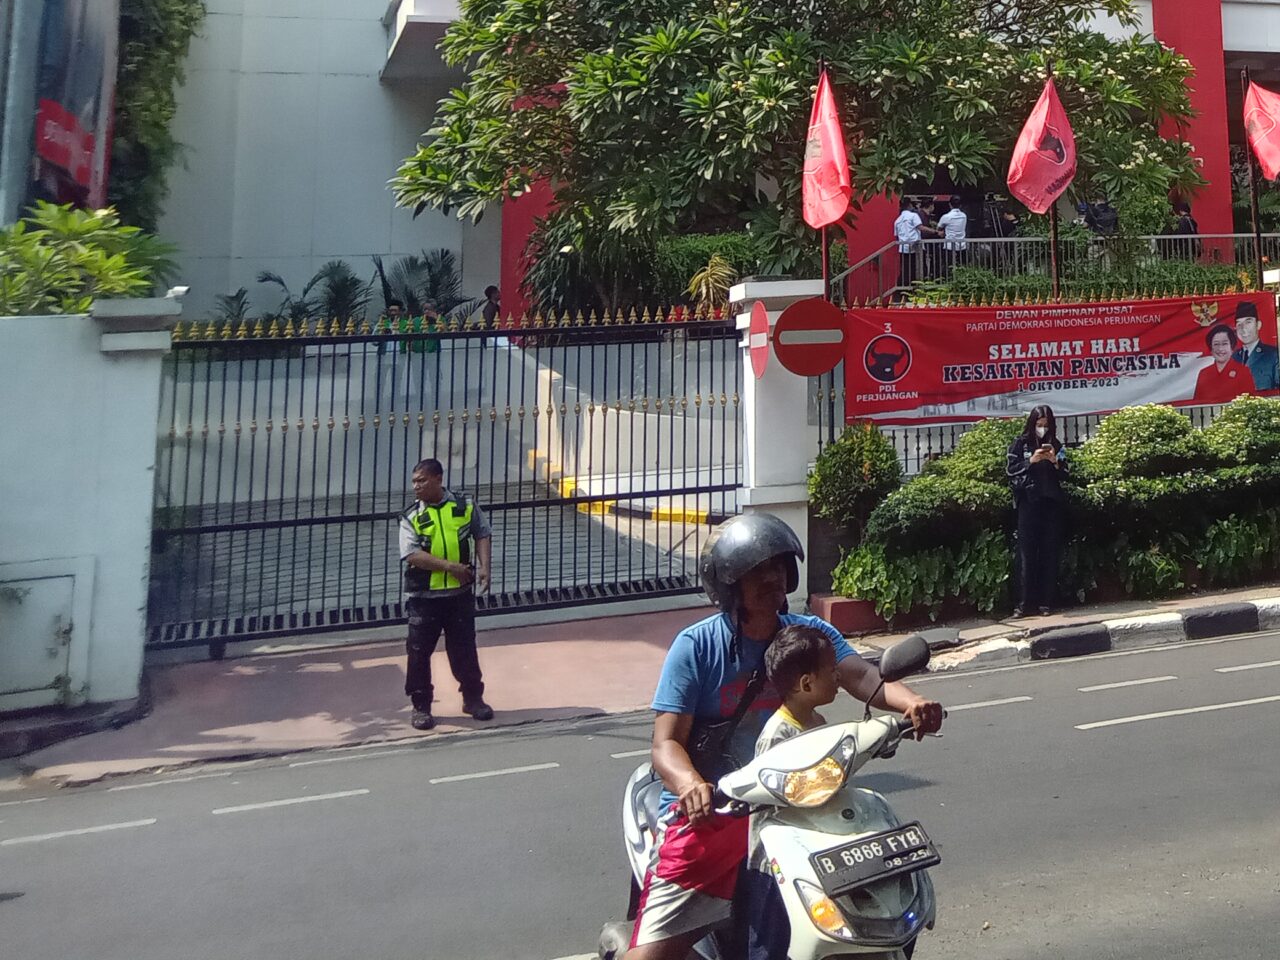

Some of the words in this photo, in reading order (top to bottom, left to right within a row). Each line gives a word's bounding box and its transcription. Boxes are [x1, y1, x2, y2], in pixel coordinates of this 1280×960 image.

[996, 309, 1038, 320] DEWAN
[1041, 307, 1095, 317] PIMPINAN
[1099, 305, 1134, 314] PUSAT
[883, 322, 892, 333] 3
[966, 323, 997, 332] PARTAI
[999, 320, 1052, 331] DEMOKRASI
[1054, 318, 1102, 328] INDONESIA
[1104, 314, 1161, 325] PERJUANGAN
[988, 340, 1083, 360] SELAMAT
[1090, 337, 1140, 353] HARI
[943, 359, 1064, 384] KESAKTIAN
[1070, 353, 1181, 376] PANCASILA
[879, 384, 897, 392] PDI
[1019, 384, 1025, 392] 1
[1029, 380, 1088, 392] OKTOBER
[1091, 377, 1119, 387] 2023
[856, 391, 918, 402] PERJUANGAN
[822, 858, 835, 874] B
